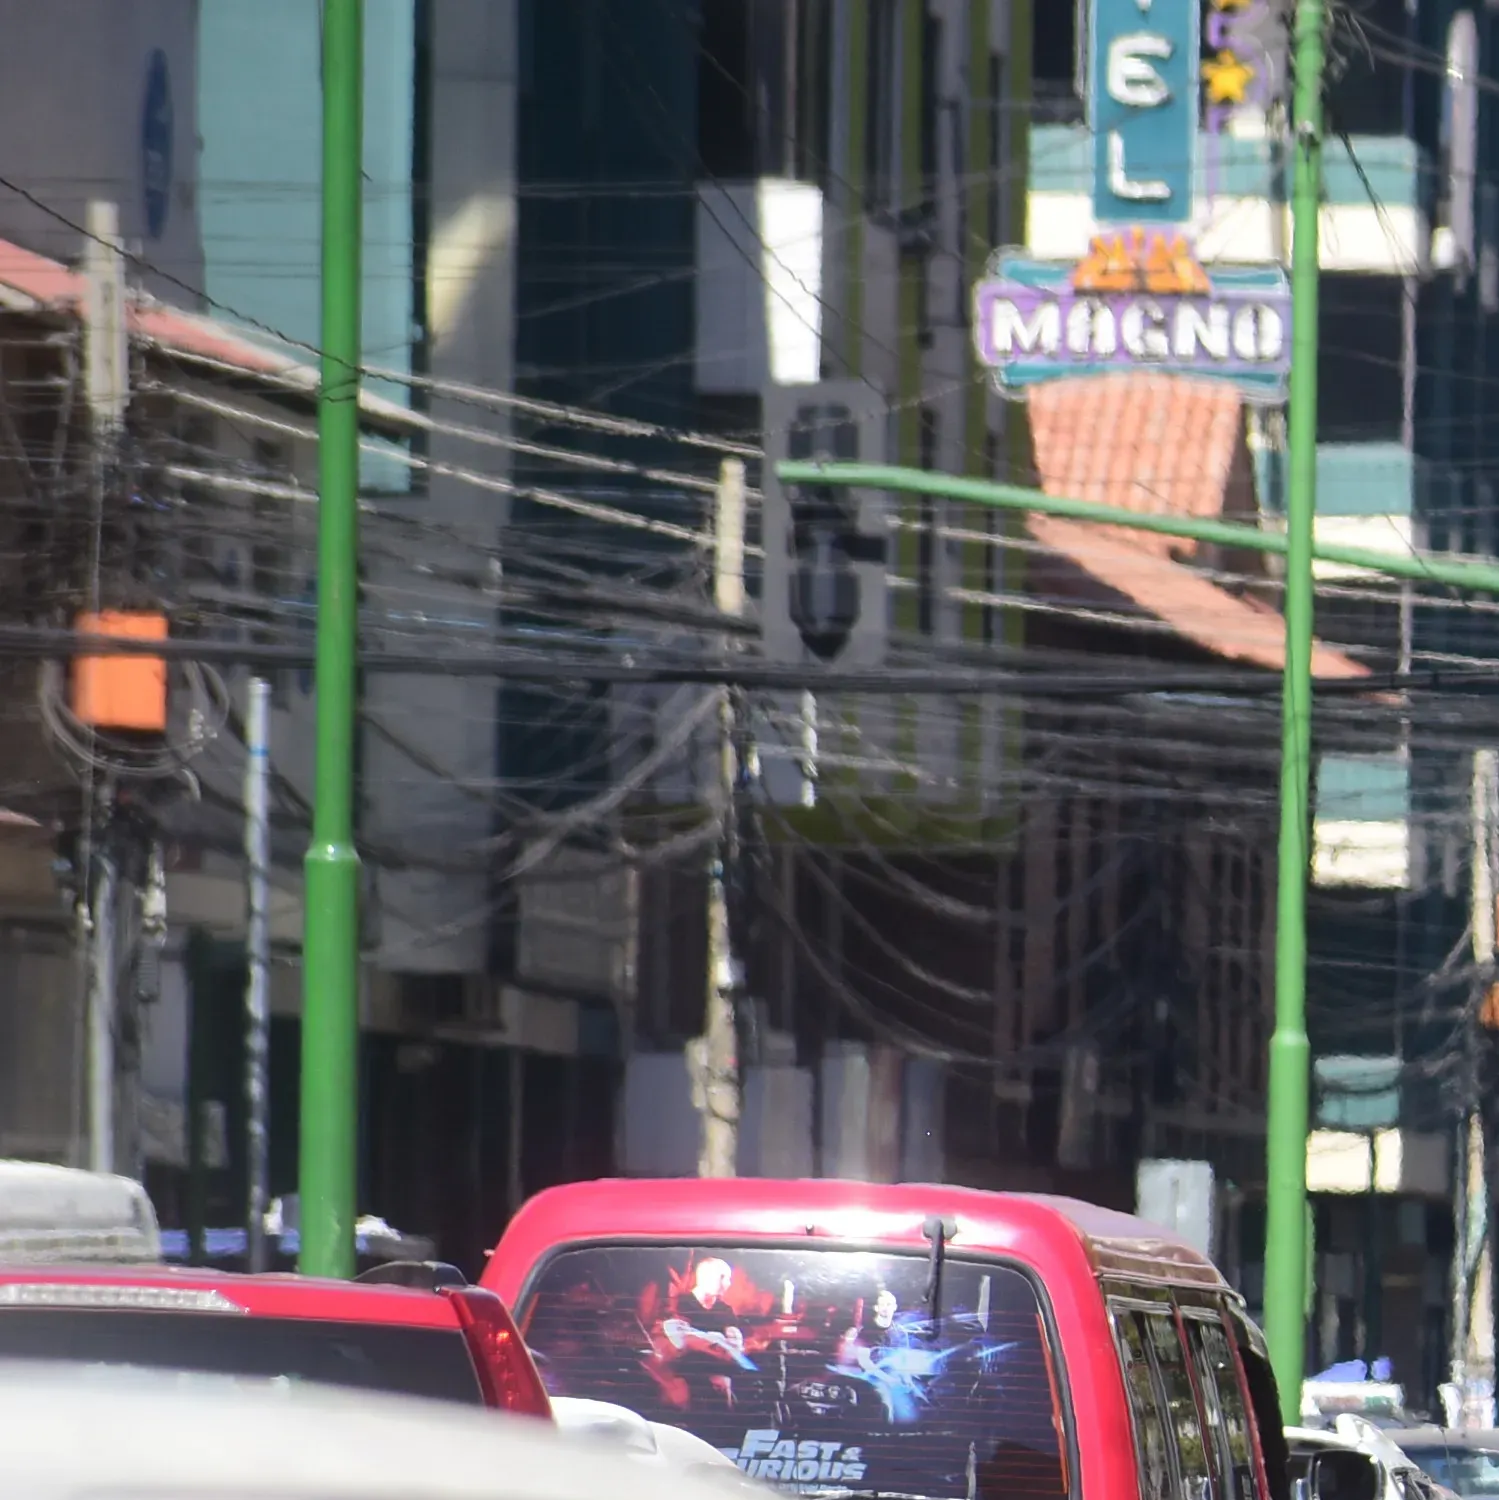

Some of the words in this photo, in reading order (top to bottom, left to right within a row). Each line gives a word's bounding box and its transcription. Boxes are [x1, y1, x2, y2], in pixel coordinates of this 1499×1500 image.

[1106, 0, 1173, 200] EL
[992, 299, 1282, 361] MAGNO
[740, 1429, 842, 1460] FAST
